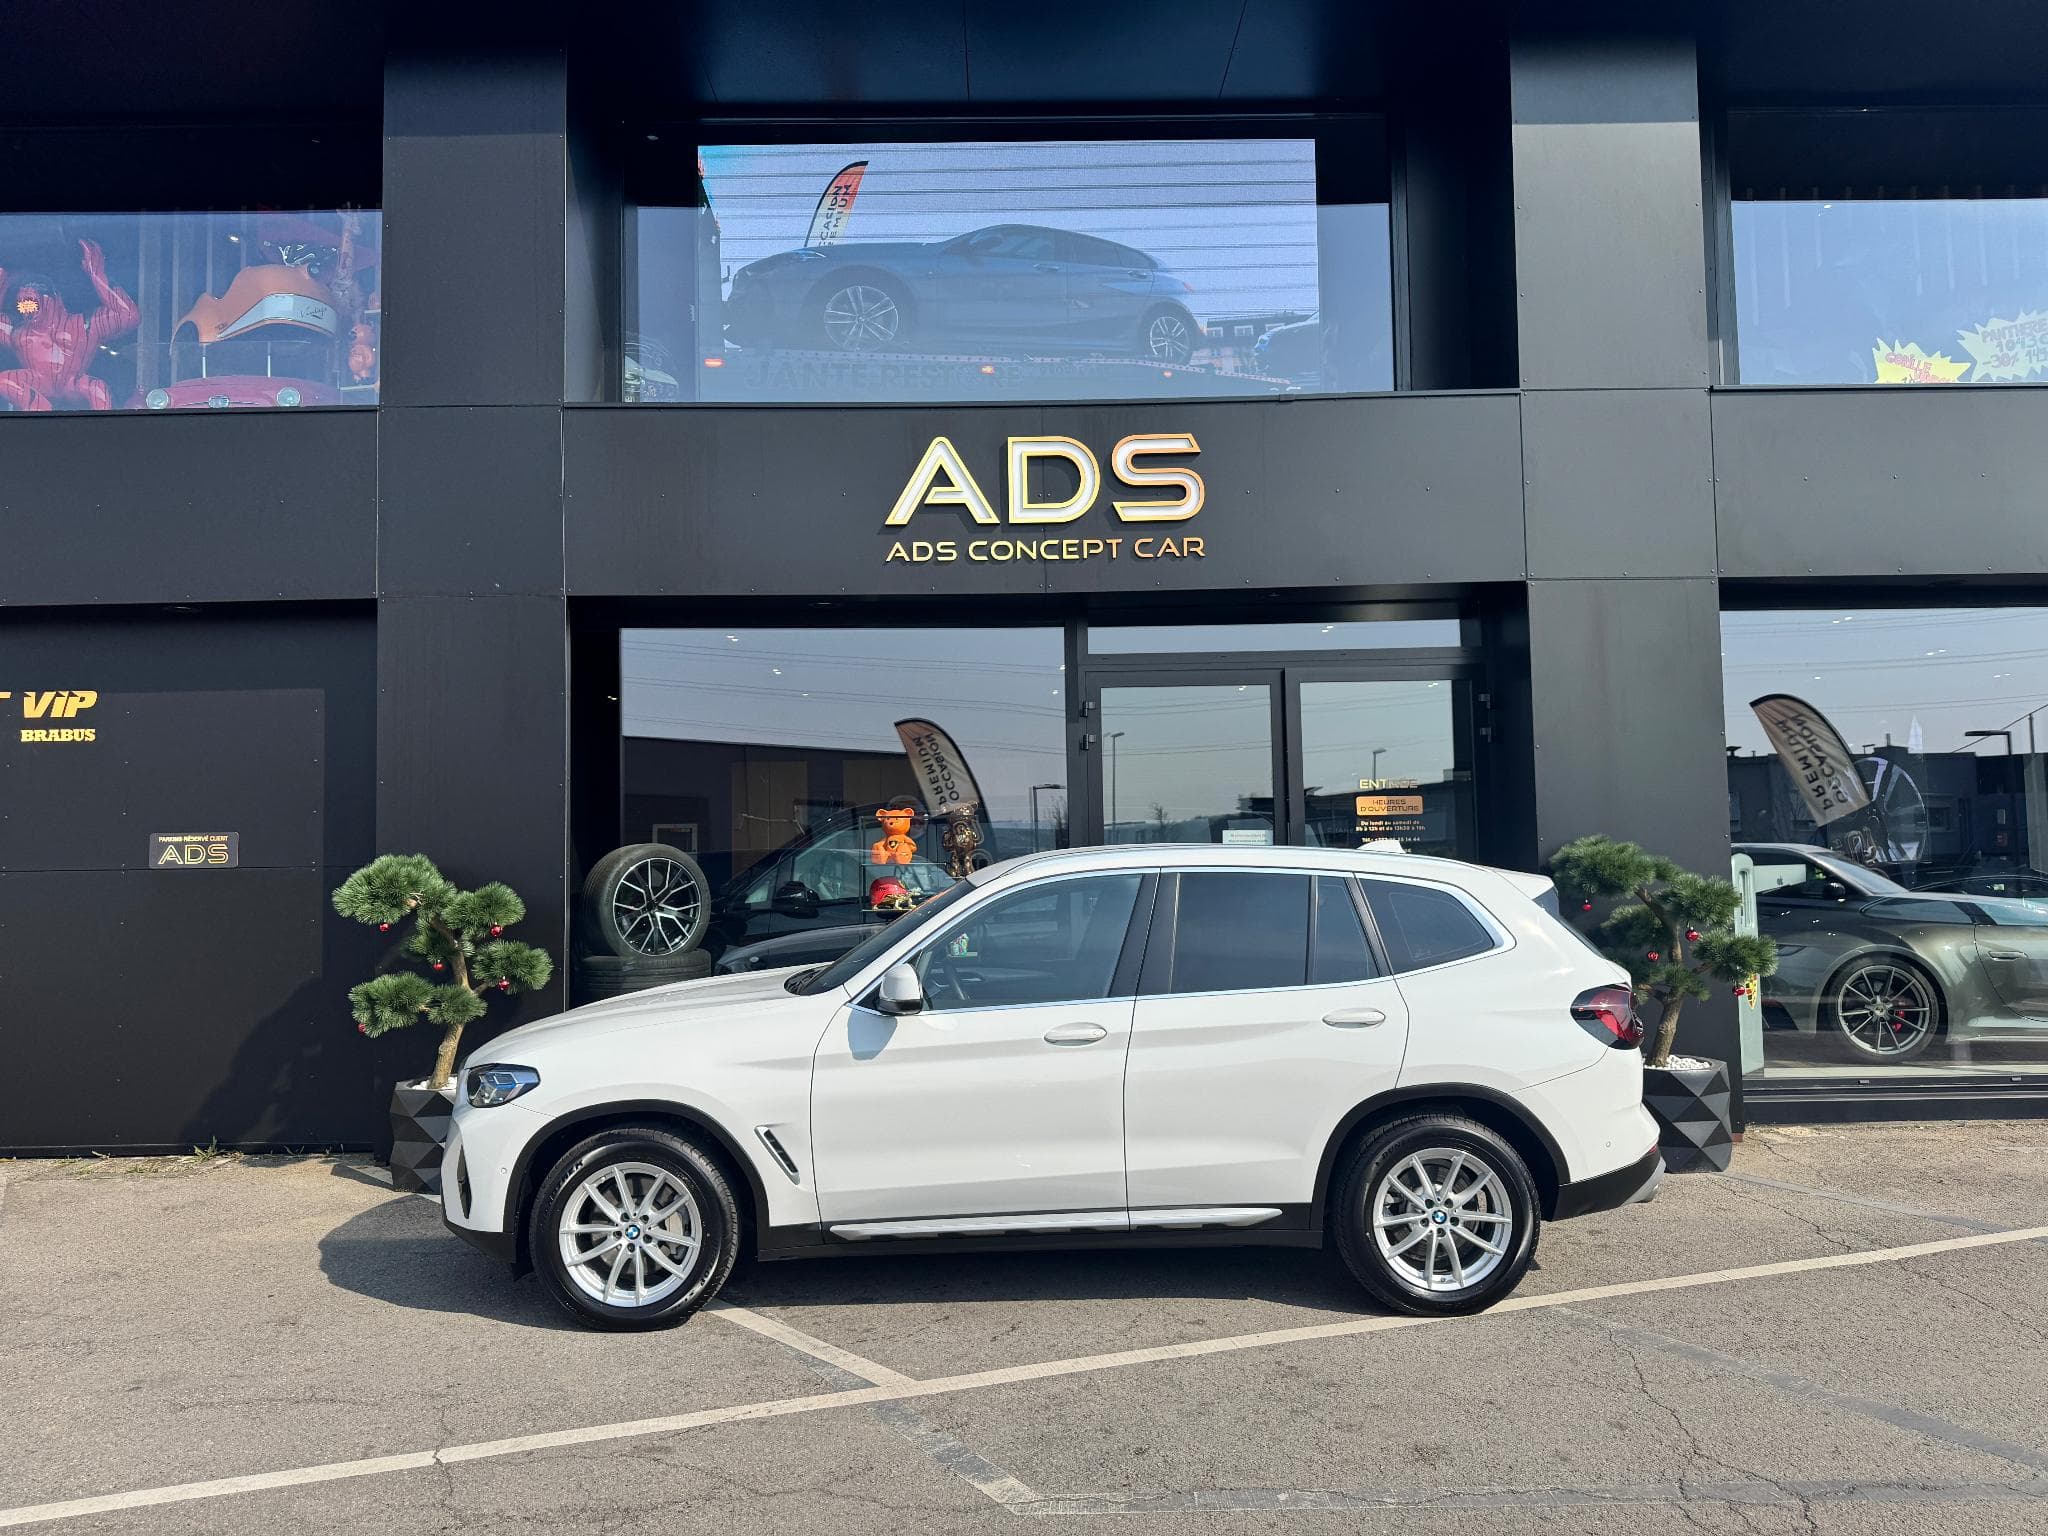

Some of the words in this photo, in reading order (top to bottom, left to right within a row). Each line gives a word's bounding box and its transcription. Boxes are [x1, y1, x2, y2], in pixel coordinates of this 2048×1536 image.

[884, 433, 1206, 525] ADS
[885, 540, 958, 562] ADS
[968, 538, 1123, 561] CONCEPT
[1133, 537, 1206, 558] CAR
[20, 728, 96, 743] BRABUS
[157, 843, 229, 865] ADS
